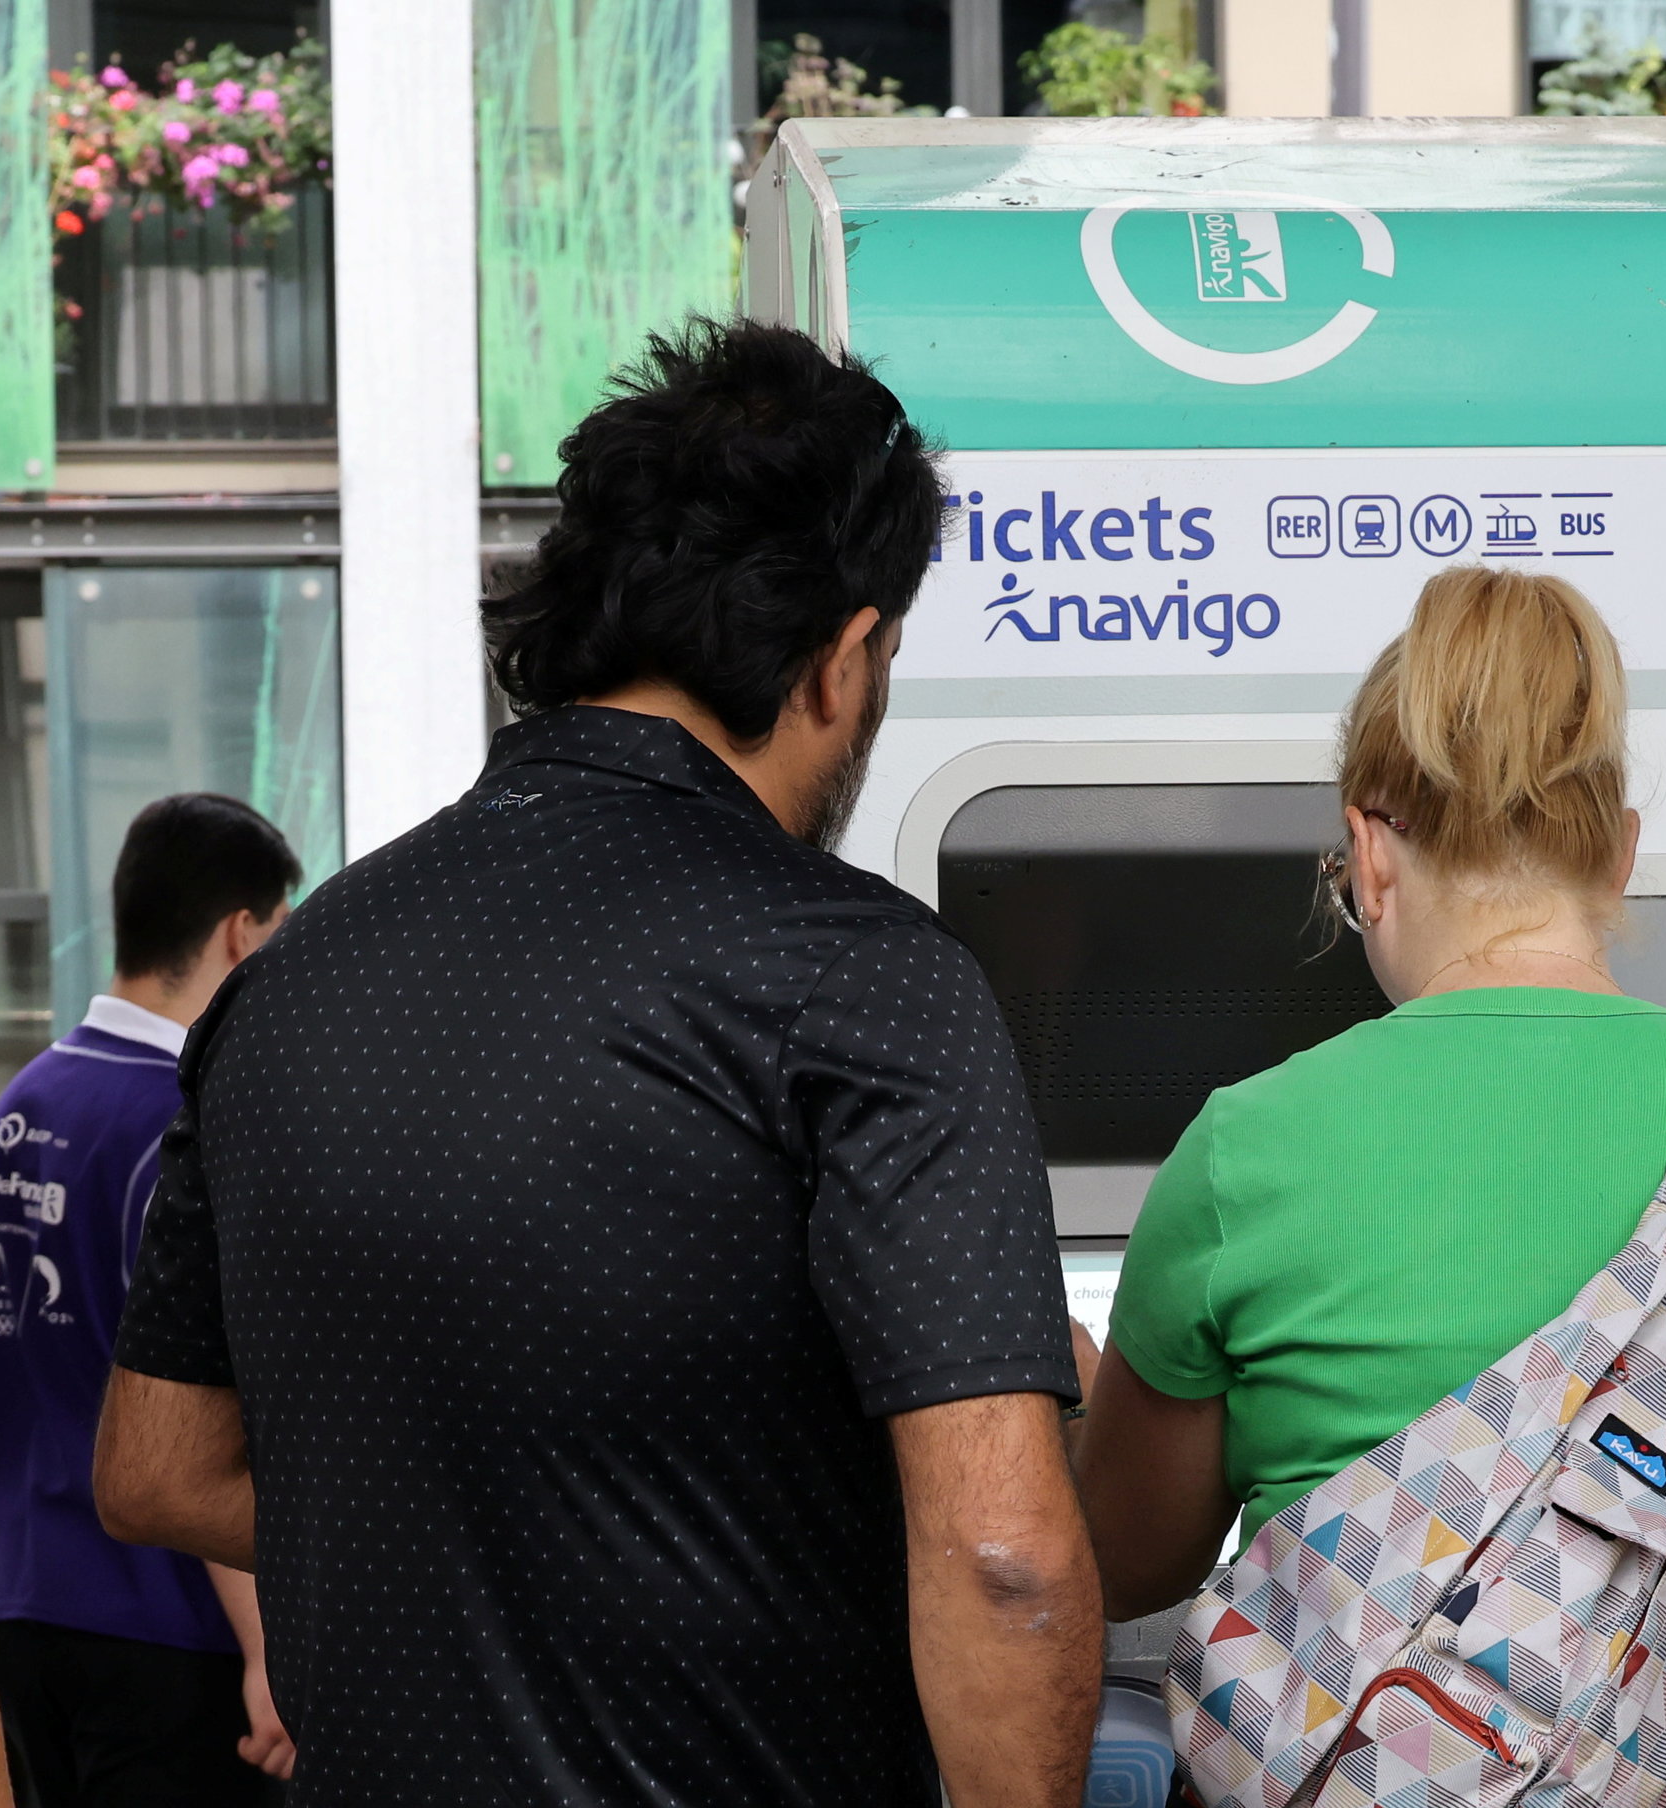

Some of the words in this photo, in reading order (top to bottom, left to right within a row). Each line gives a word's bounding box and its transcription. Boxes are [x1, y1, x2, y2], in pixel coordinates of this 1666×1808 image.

[1202, 213, 1233, 283] navigo
[1276, 515, 1322, 538] RER
[1425, 508, 1457, 542] M
[1560, 513, 1606, 536] BUS
[1049, 579, 1281, 658] navigo
[1609, 1438, 1659, 1479] KAVU
